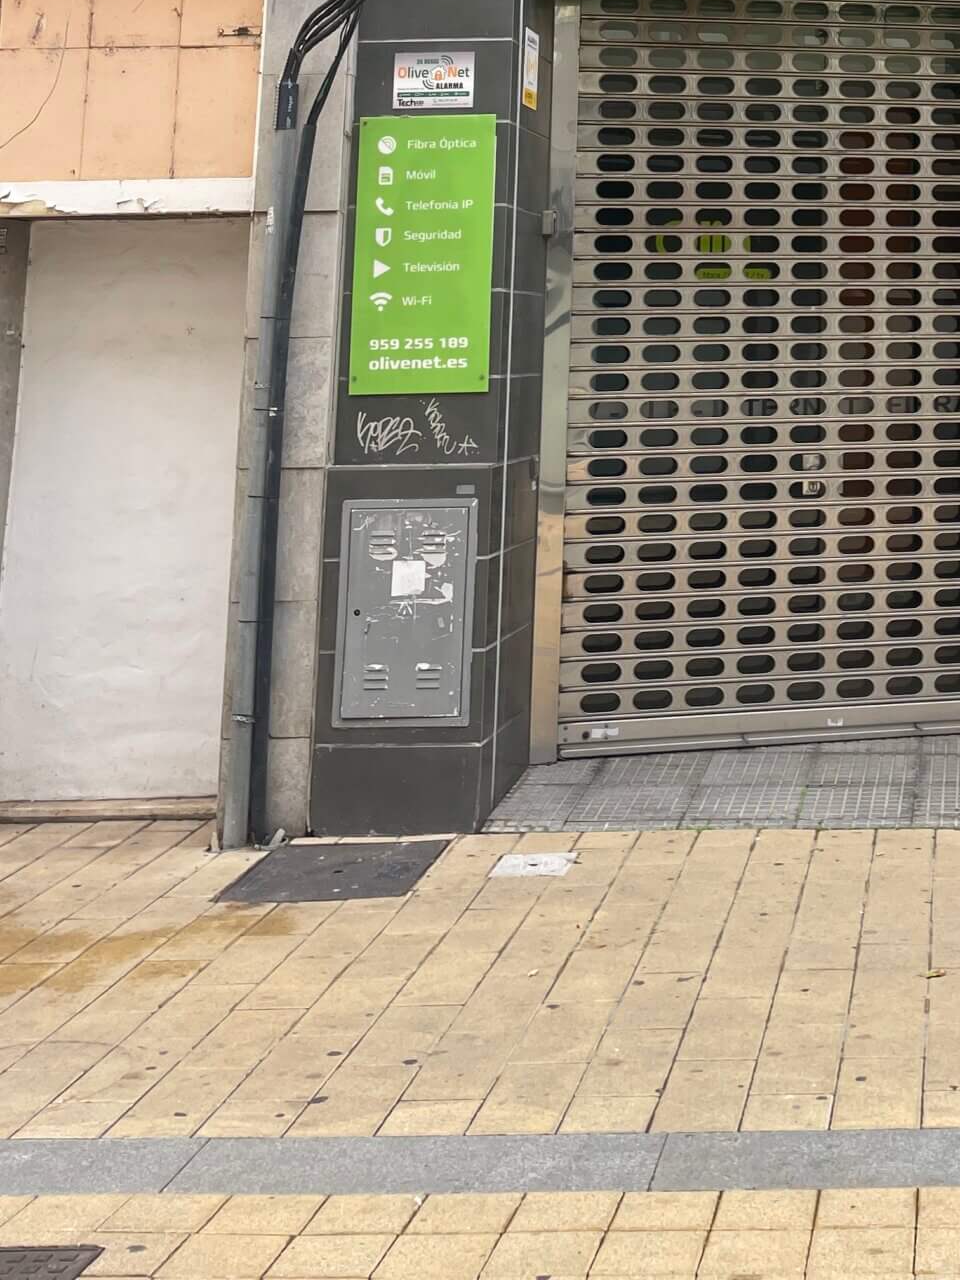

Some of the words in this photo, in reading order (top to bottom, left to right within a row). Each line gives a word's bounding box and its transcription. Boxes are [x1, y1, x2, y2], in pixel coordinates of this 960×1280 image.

[398, 67, 429, 78] Olive
[448, 67, 470, 78] Net
[407, 140, 436, 150] Fibra
[439, 138, 477, 150] Óptica
[406, 169, 436, 180] Móvil
[462, 199, 474, 209] IP
[404, 229, 462, 242] Seguridad
[404, 261, 460, 272] Televisión
[402, 296, 432, 306] Wi-Fi
[369, 339, 400, 350] 959
[404, 338, 434, 350] 255
[440, 337, 469, 349] 189
[369, 356, 468, 371] olivenet.es
